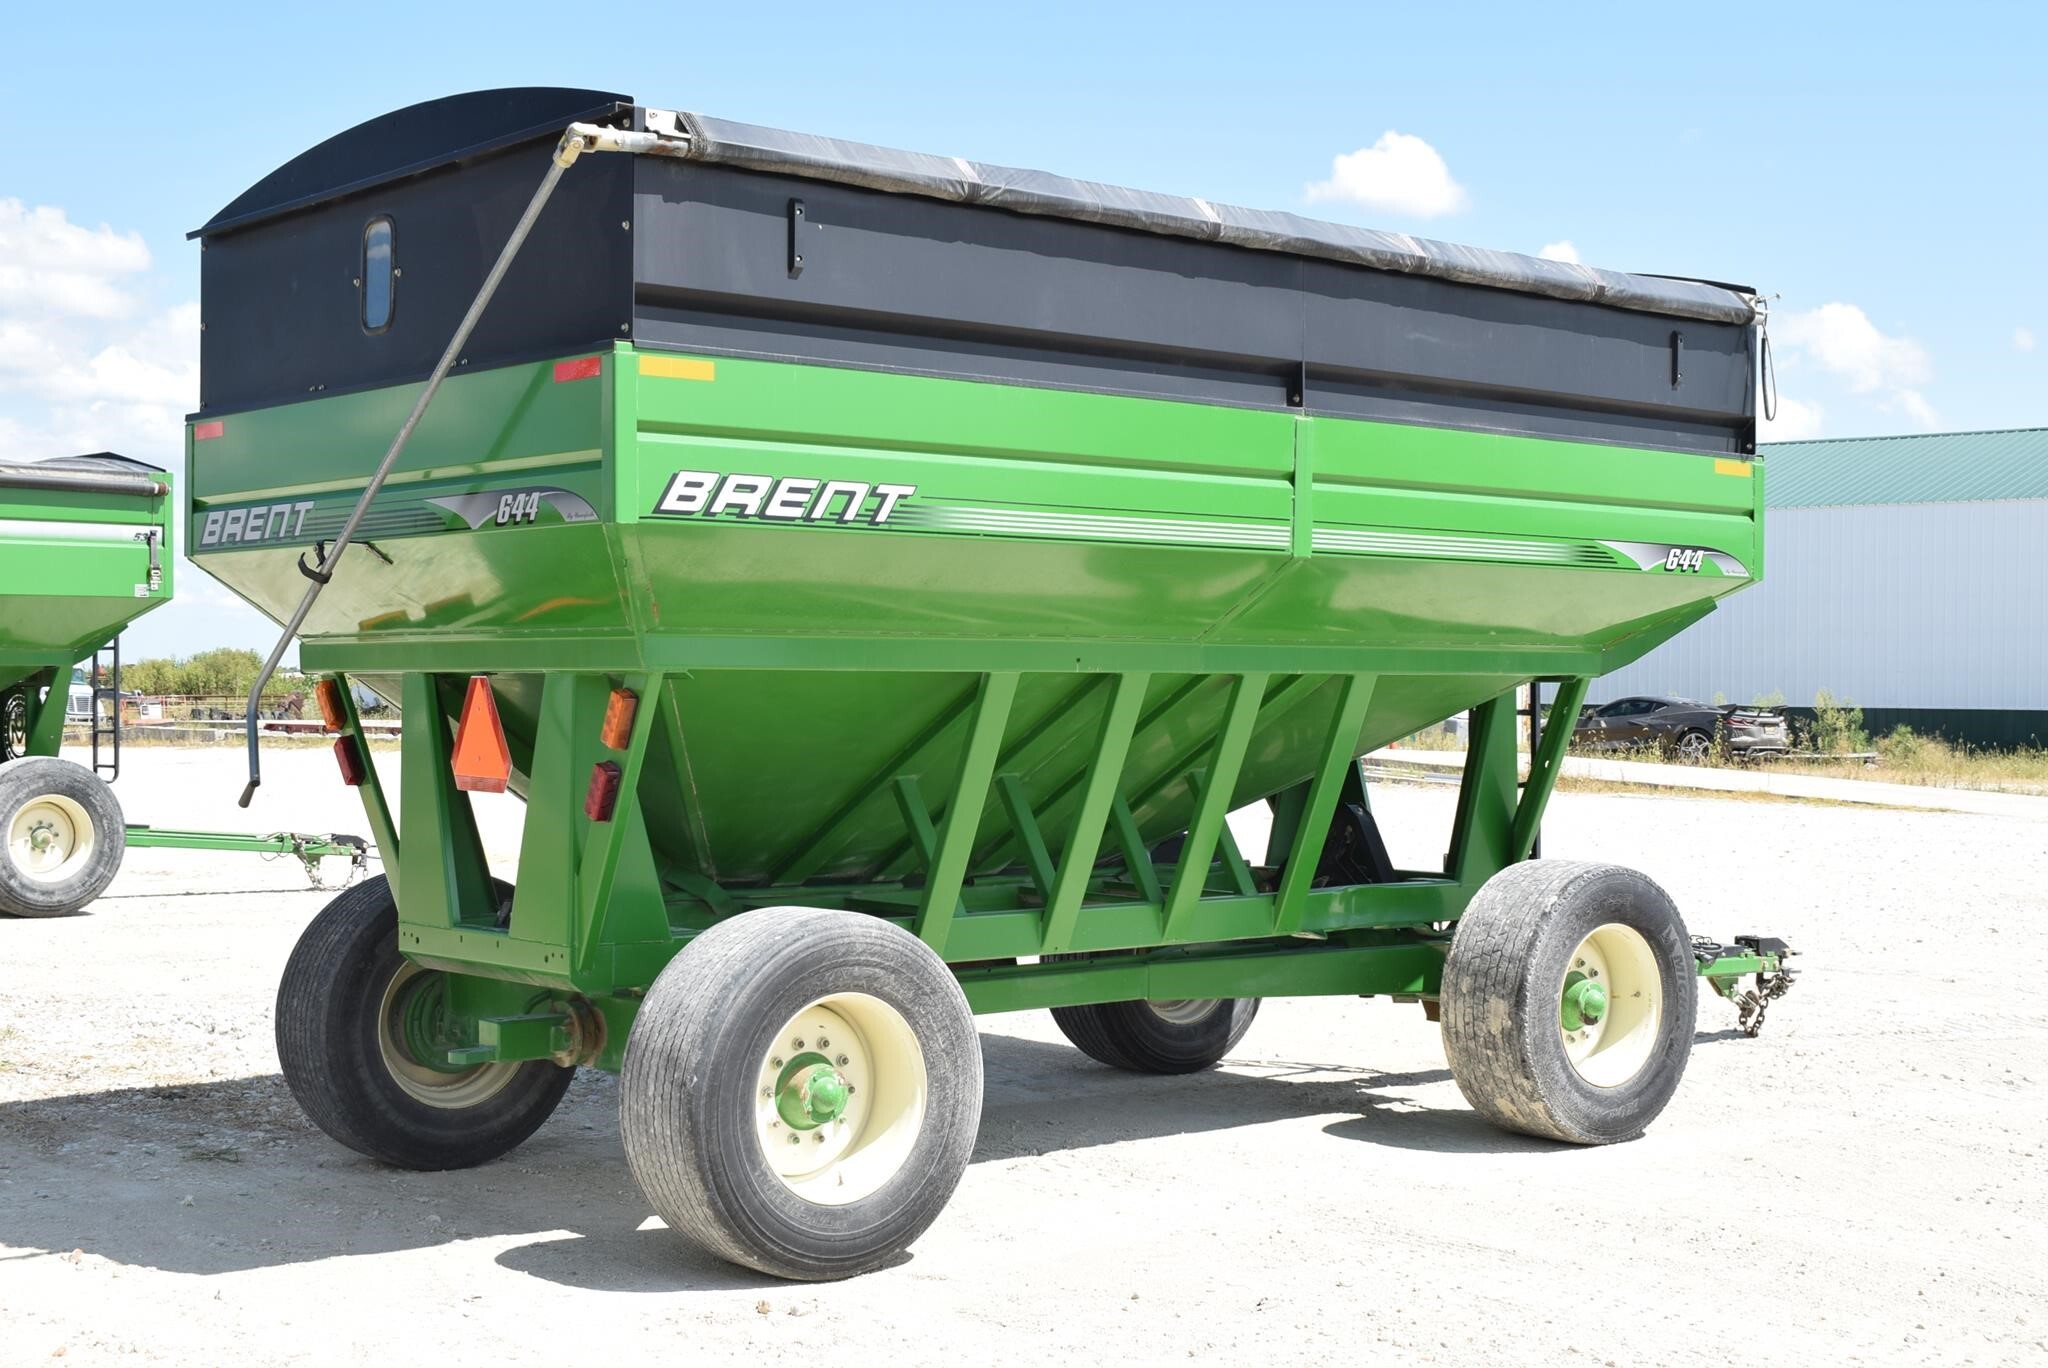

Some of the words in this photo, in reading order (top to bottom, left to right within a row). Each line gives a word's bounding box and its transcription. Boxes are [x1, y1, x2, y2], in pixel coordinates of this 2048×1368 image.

[496, 491, 541, 527] 644
[654, 470, 917, 526] BRENT
[199, 500, 315, 549] BRENT
[1665, 547, 1705, 571] 644
